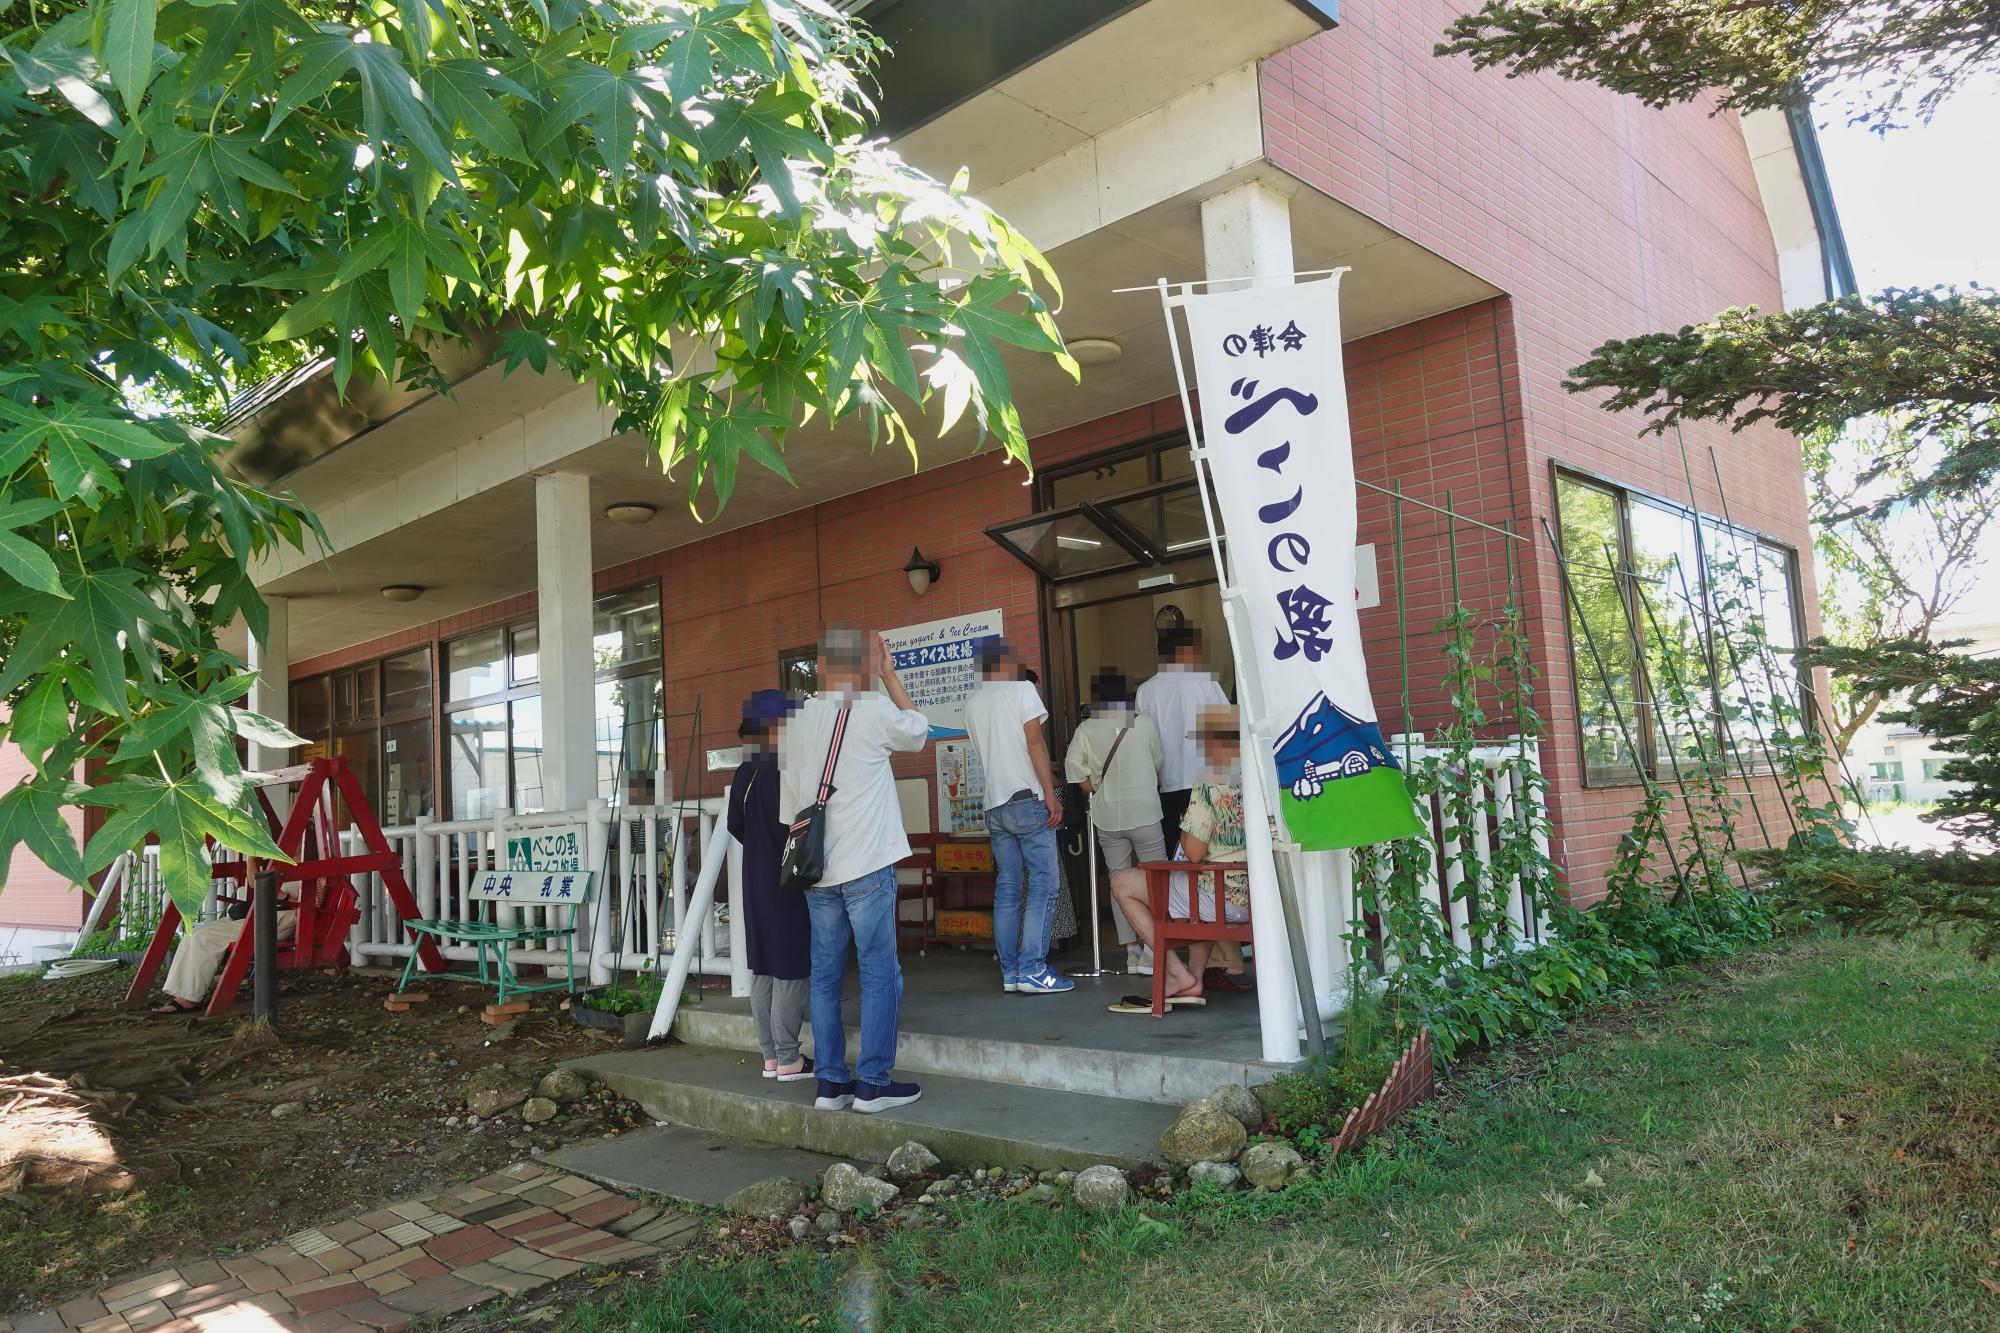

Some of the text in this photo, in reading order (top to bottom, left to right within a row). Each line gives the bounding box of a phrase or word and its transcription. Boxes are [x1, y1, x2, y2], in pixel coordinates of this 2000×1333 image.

[910, 632, 934, 647] yogurt
[938, 628, 945, 639] &
[950, 626, 961, 636] Ice
[963, 623, 989, 636] Cream
[920, 640, 973, 664] アイス牧場
[532, 832, 579, 857] べこの乳
[483, 875, 574, 898] 中央 乳業
